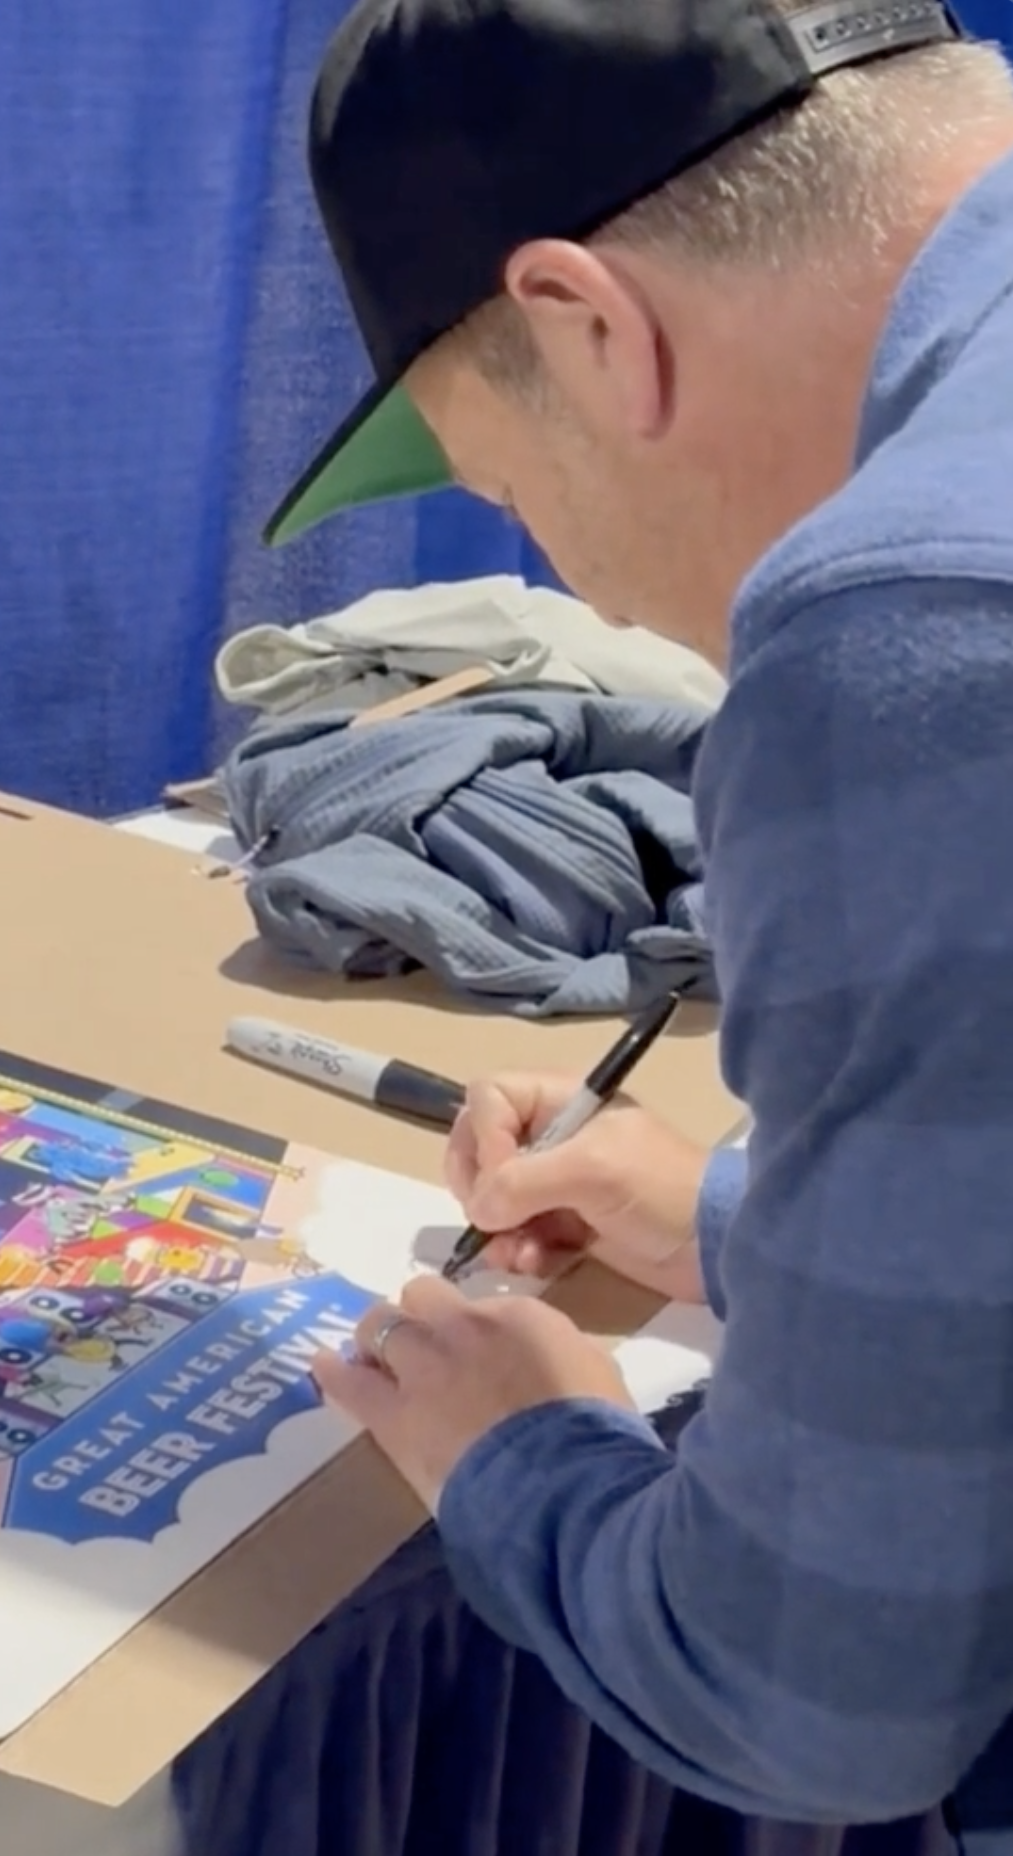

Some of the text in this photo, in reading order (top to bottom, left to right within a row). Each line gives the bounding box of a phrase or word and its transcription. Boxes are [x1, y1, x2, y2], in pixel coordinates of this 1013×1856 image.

[31, 1288, 312, 1492] GREAT AMERICAN
[78, 1431, 217, 1517] BEER
